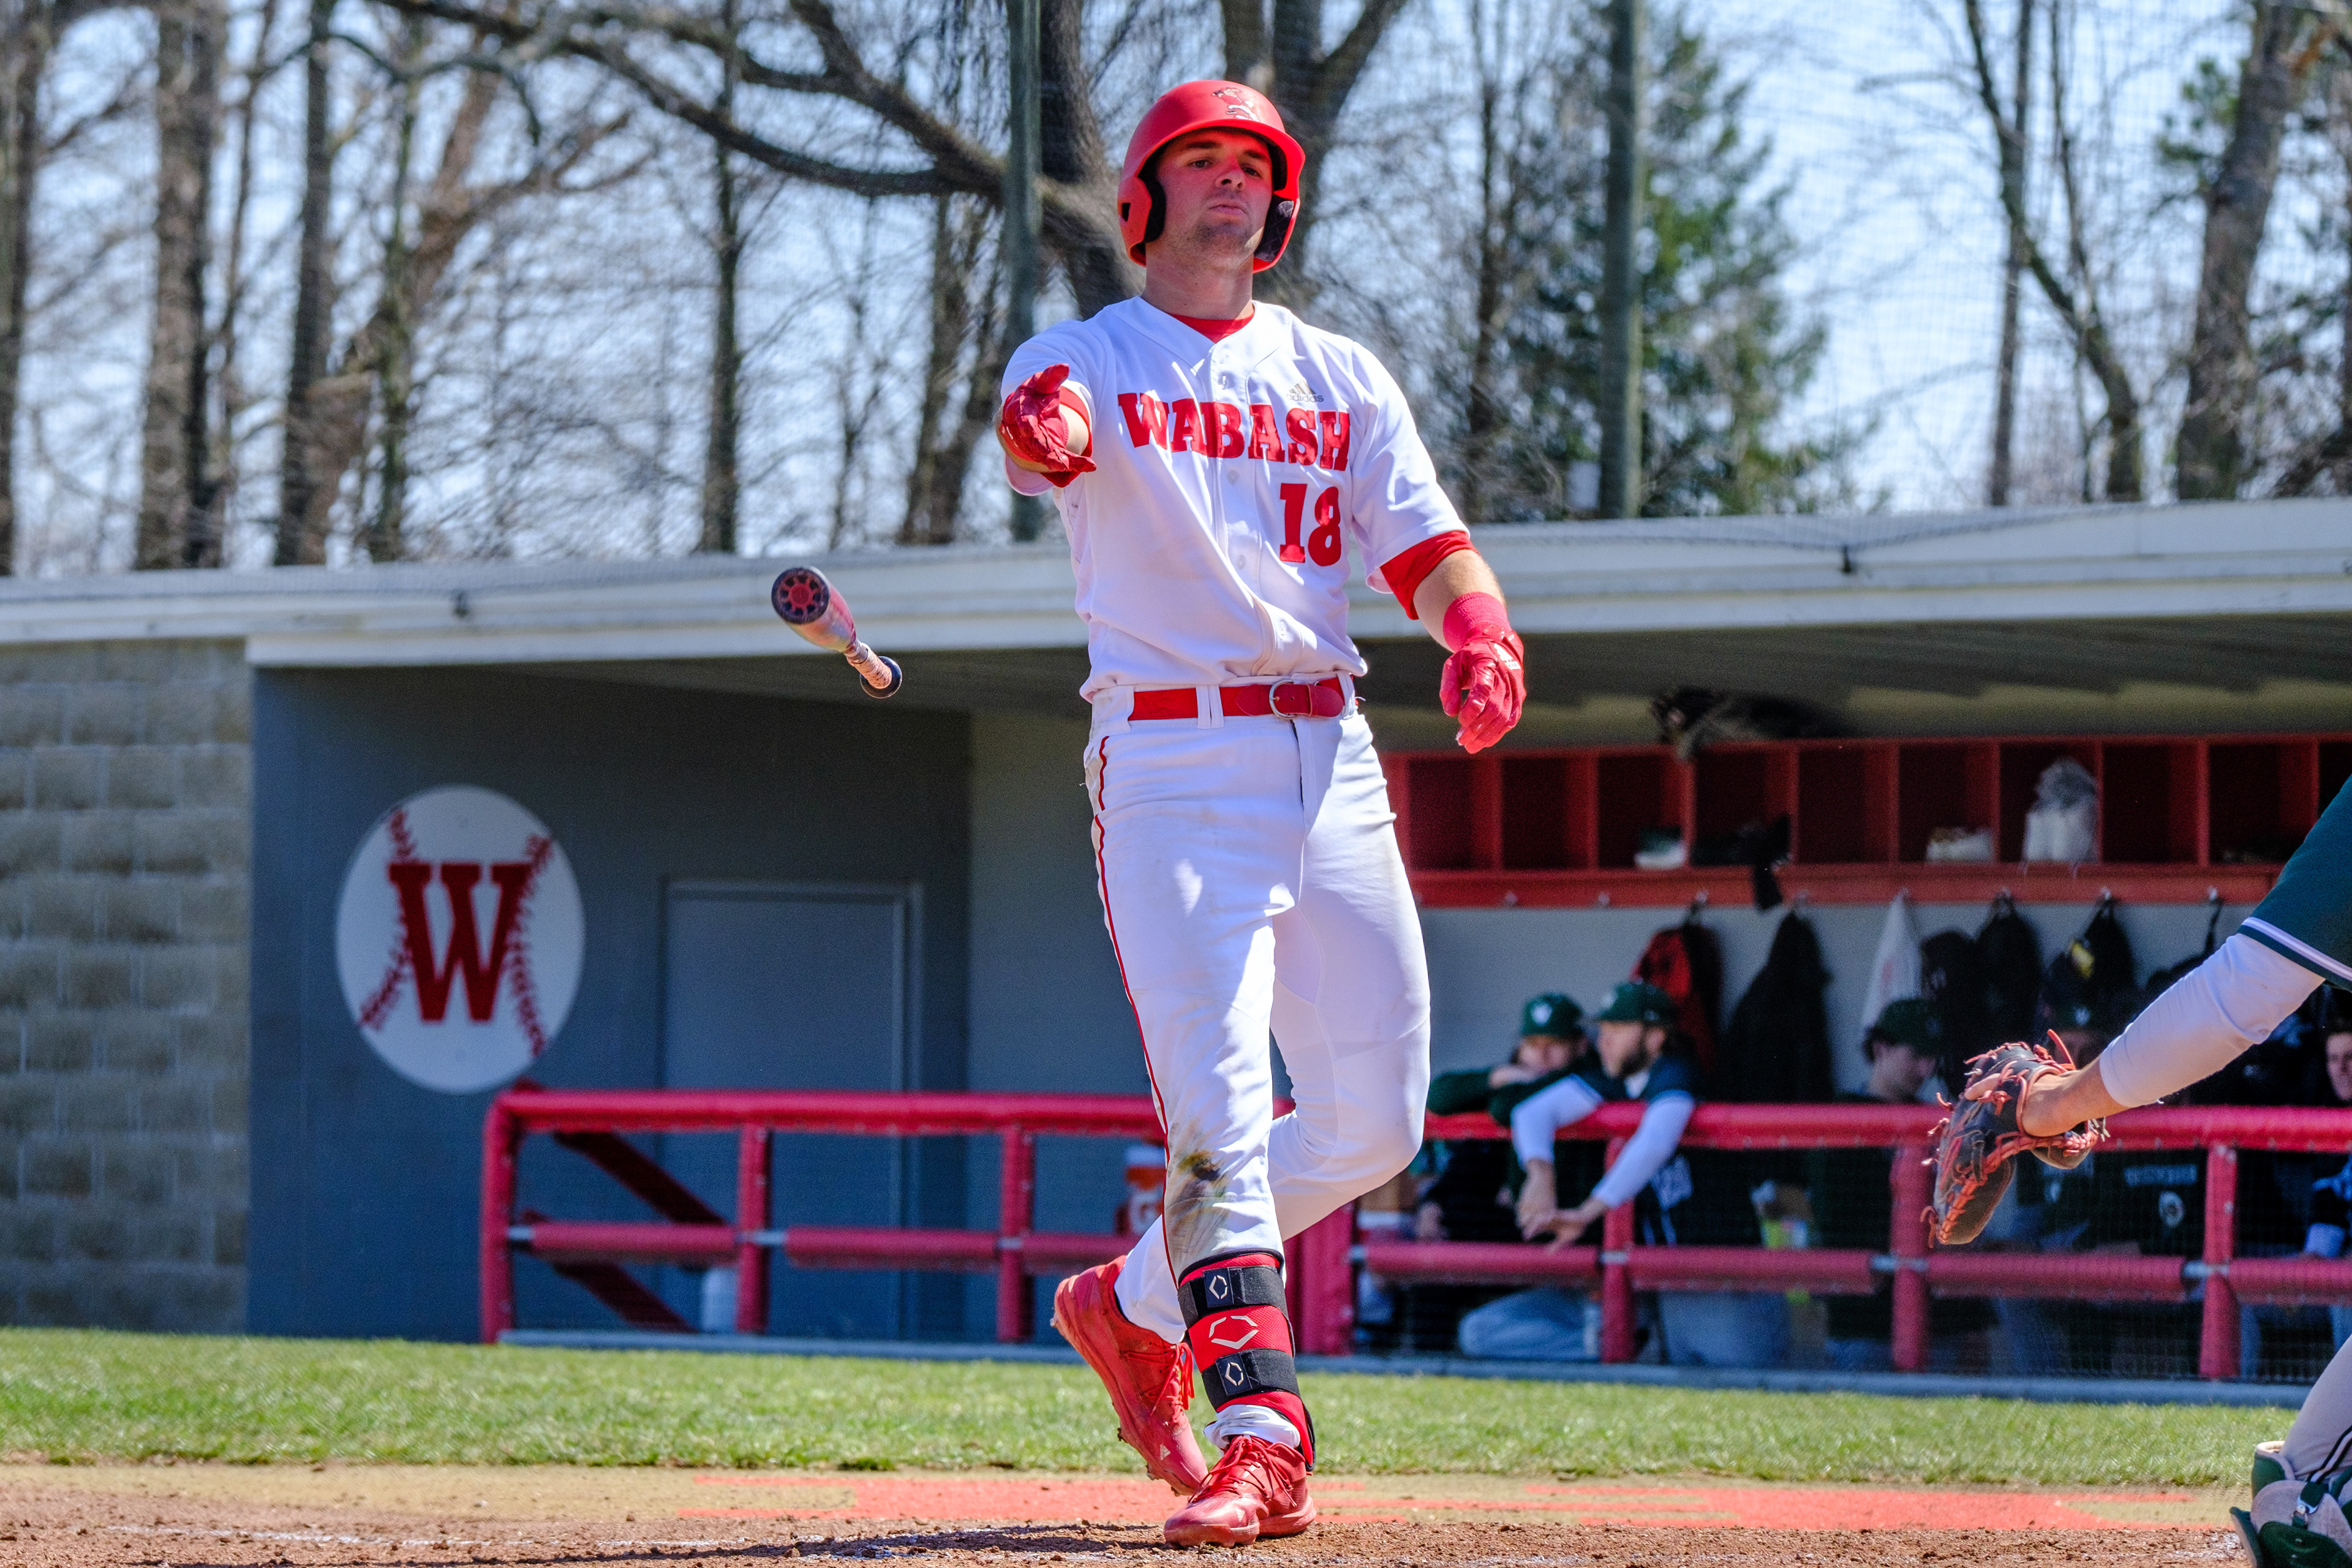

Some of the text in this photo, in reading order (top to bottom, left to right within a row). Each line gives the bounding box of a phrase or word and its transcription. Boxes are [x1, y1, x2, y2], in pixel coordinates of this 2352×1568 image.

[1118, 392, 1350, 471] WABASH
[1286, 393, 1324, 402] adidas
[1280, 483, 1341, 567] 18
[388, 862, 532, 1022] W
